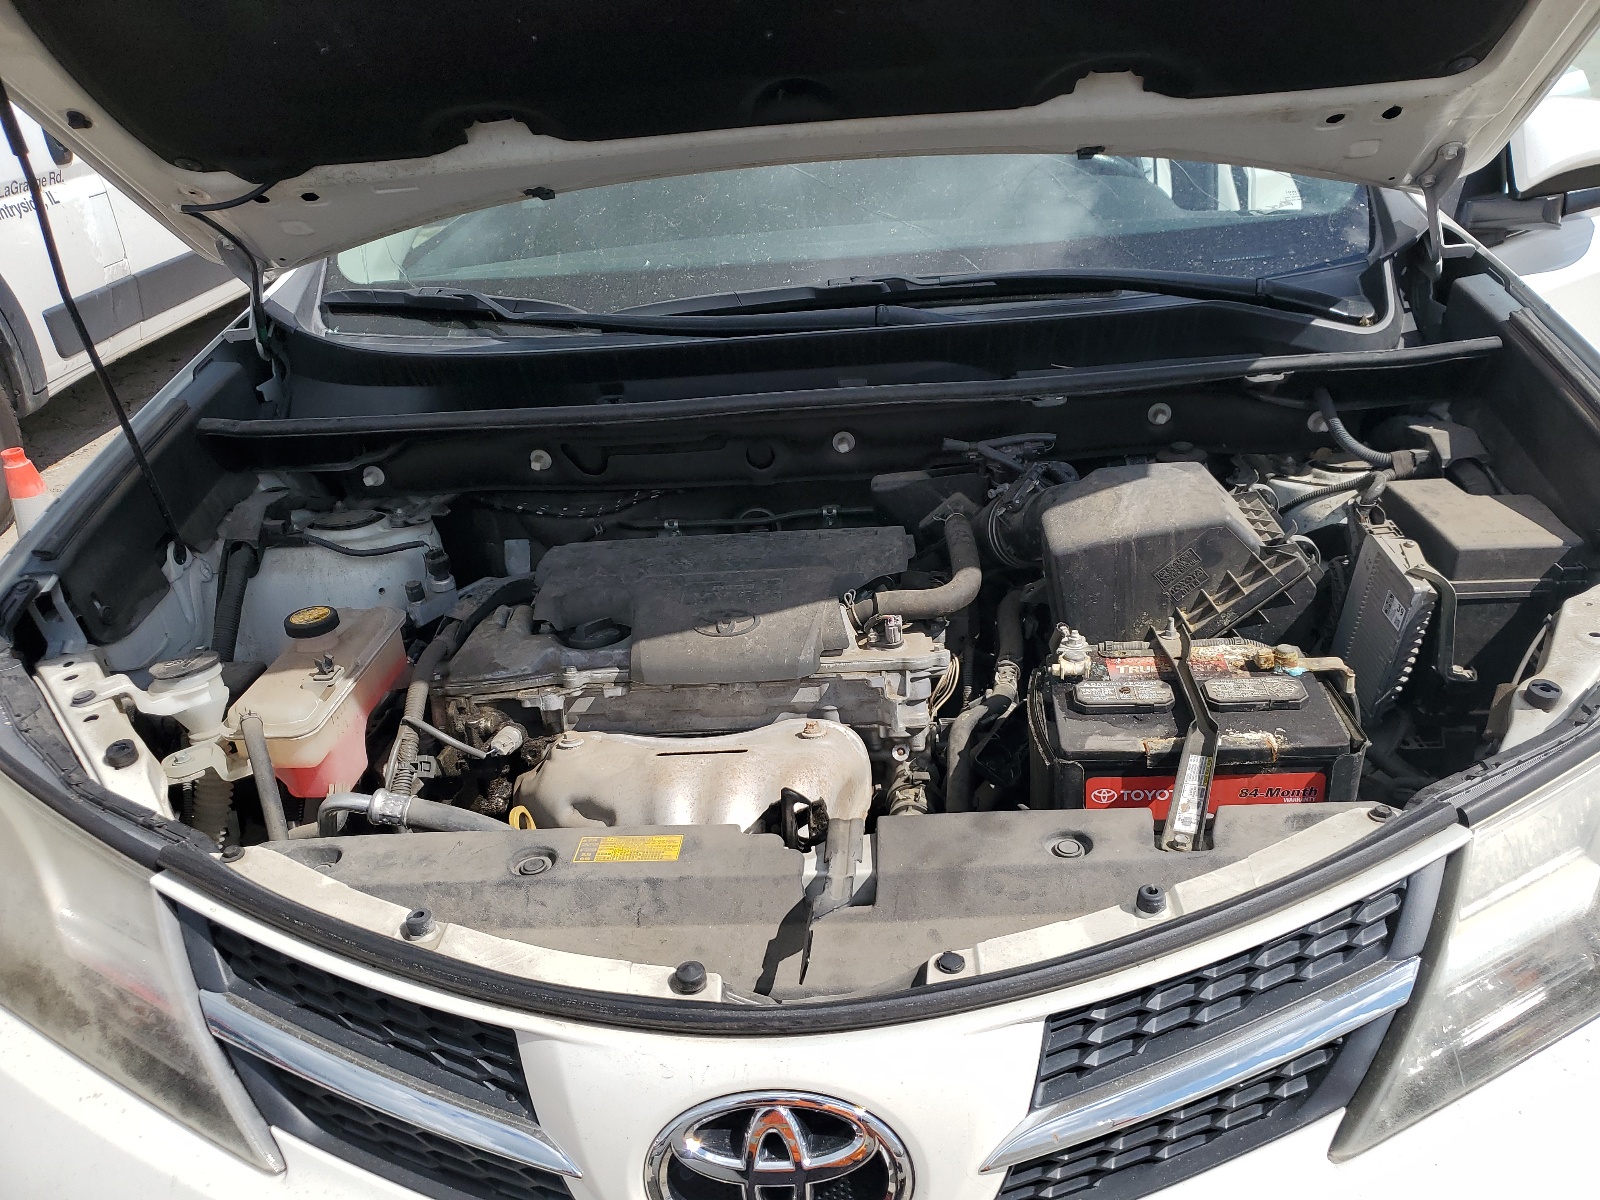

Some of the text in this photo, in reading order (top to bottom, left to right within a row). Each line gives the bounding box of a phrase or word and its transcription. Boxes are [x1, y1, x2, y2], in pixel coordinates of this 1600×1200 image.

[0, 170, 65, 198] aGrage Rd.
[0, 190, 61, 220] ntrysid, IL
[1120, 789, 1174, 801] TOYO
[1238, 786, 1318, 799] 84-Month
